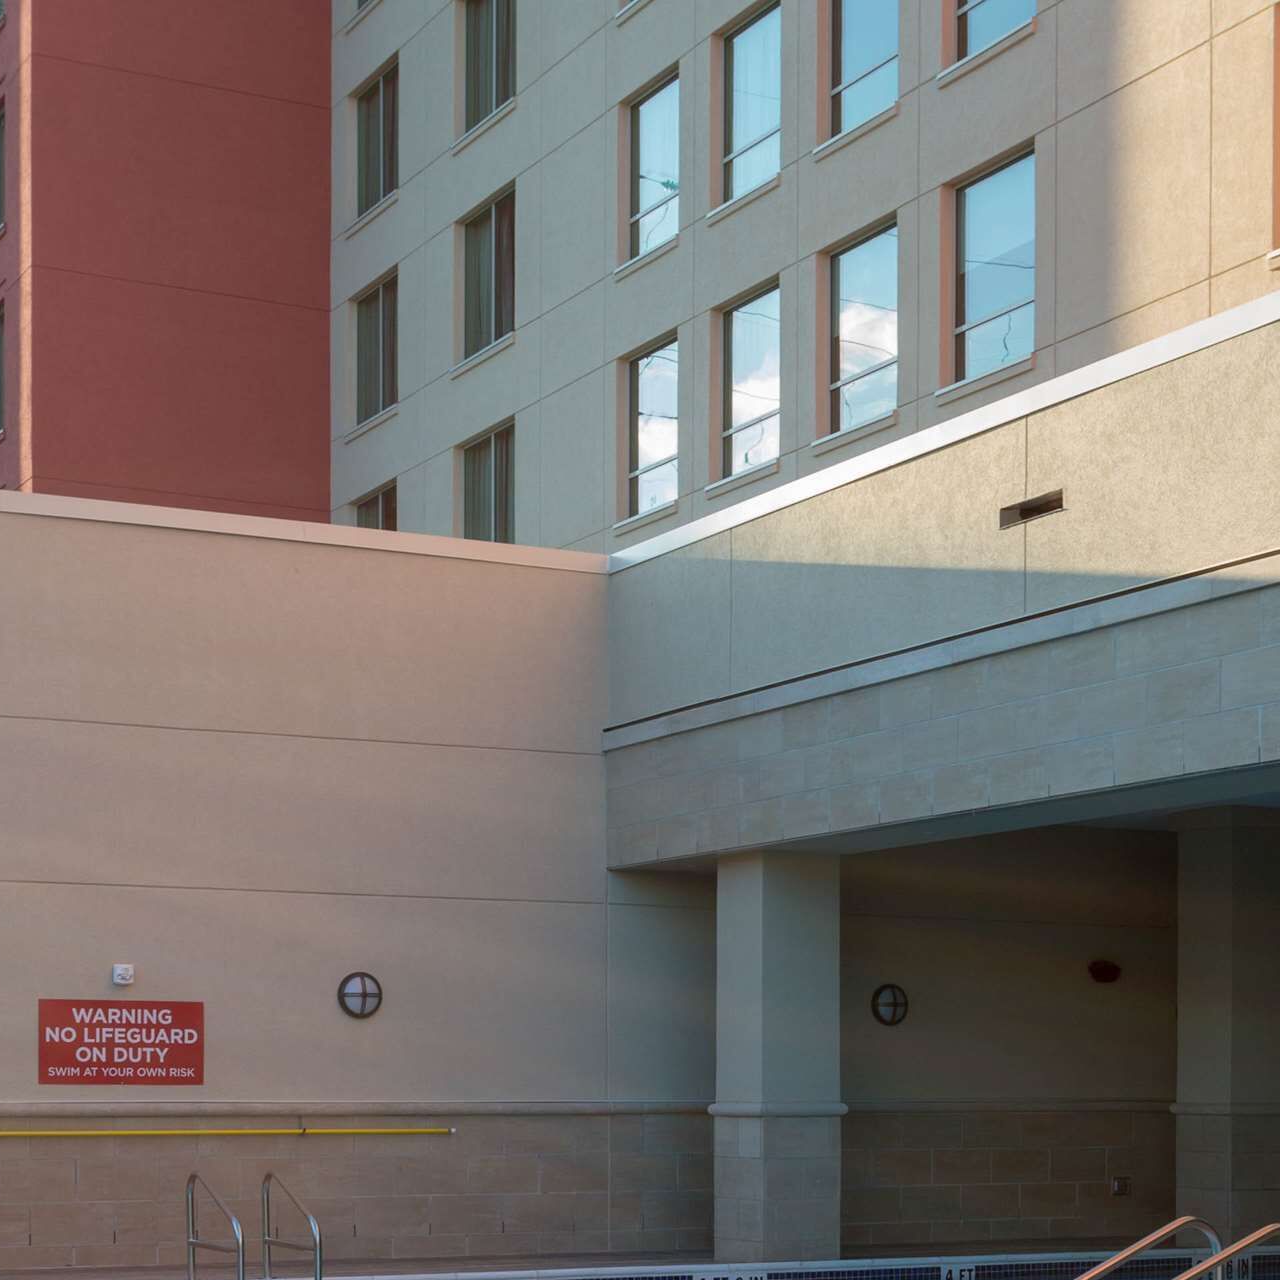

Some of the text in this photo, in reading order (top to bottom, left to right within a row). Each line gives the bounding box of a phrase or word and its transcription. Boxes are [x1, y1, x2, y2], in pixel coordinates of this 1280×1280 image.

[71, 1007, 173, 1025] WARNING
[45, 1026, 198, 1044] NO LIFEGUARD
[75, 1047, 169, 1063] ON DUTY
[48, 1066, 195, 1077] SWIM AT YOUR OWN RISK
